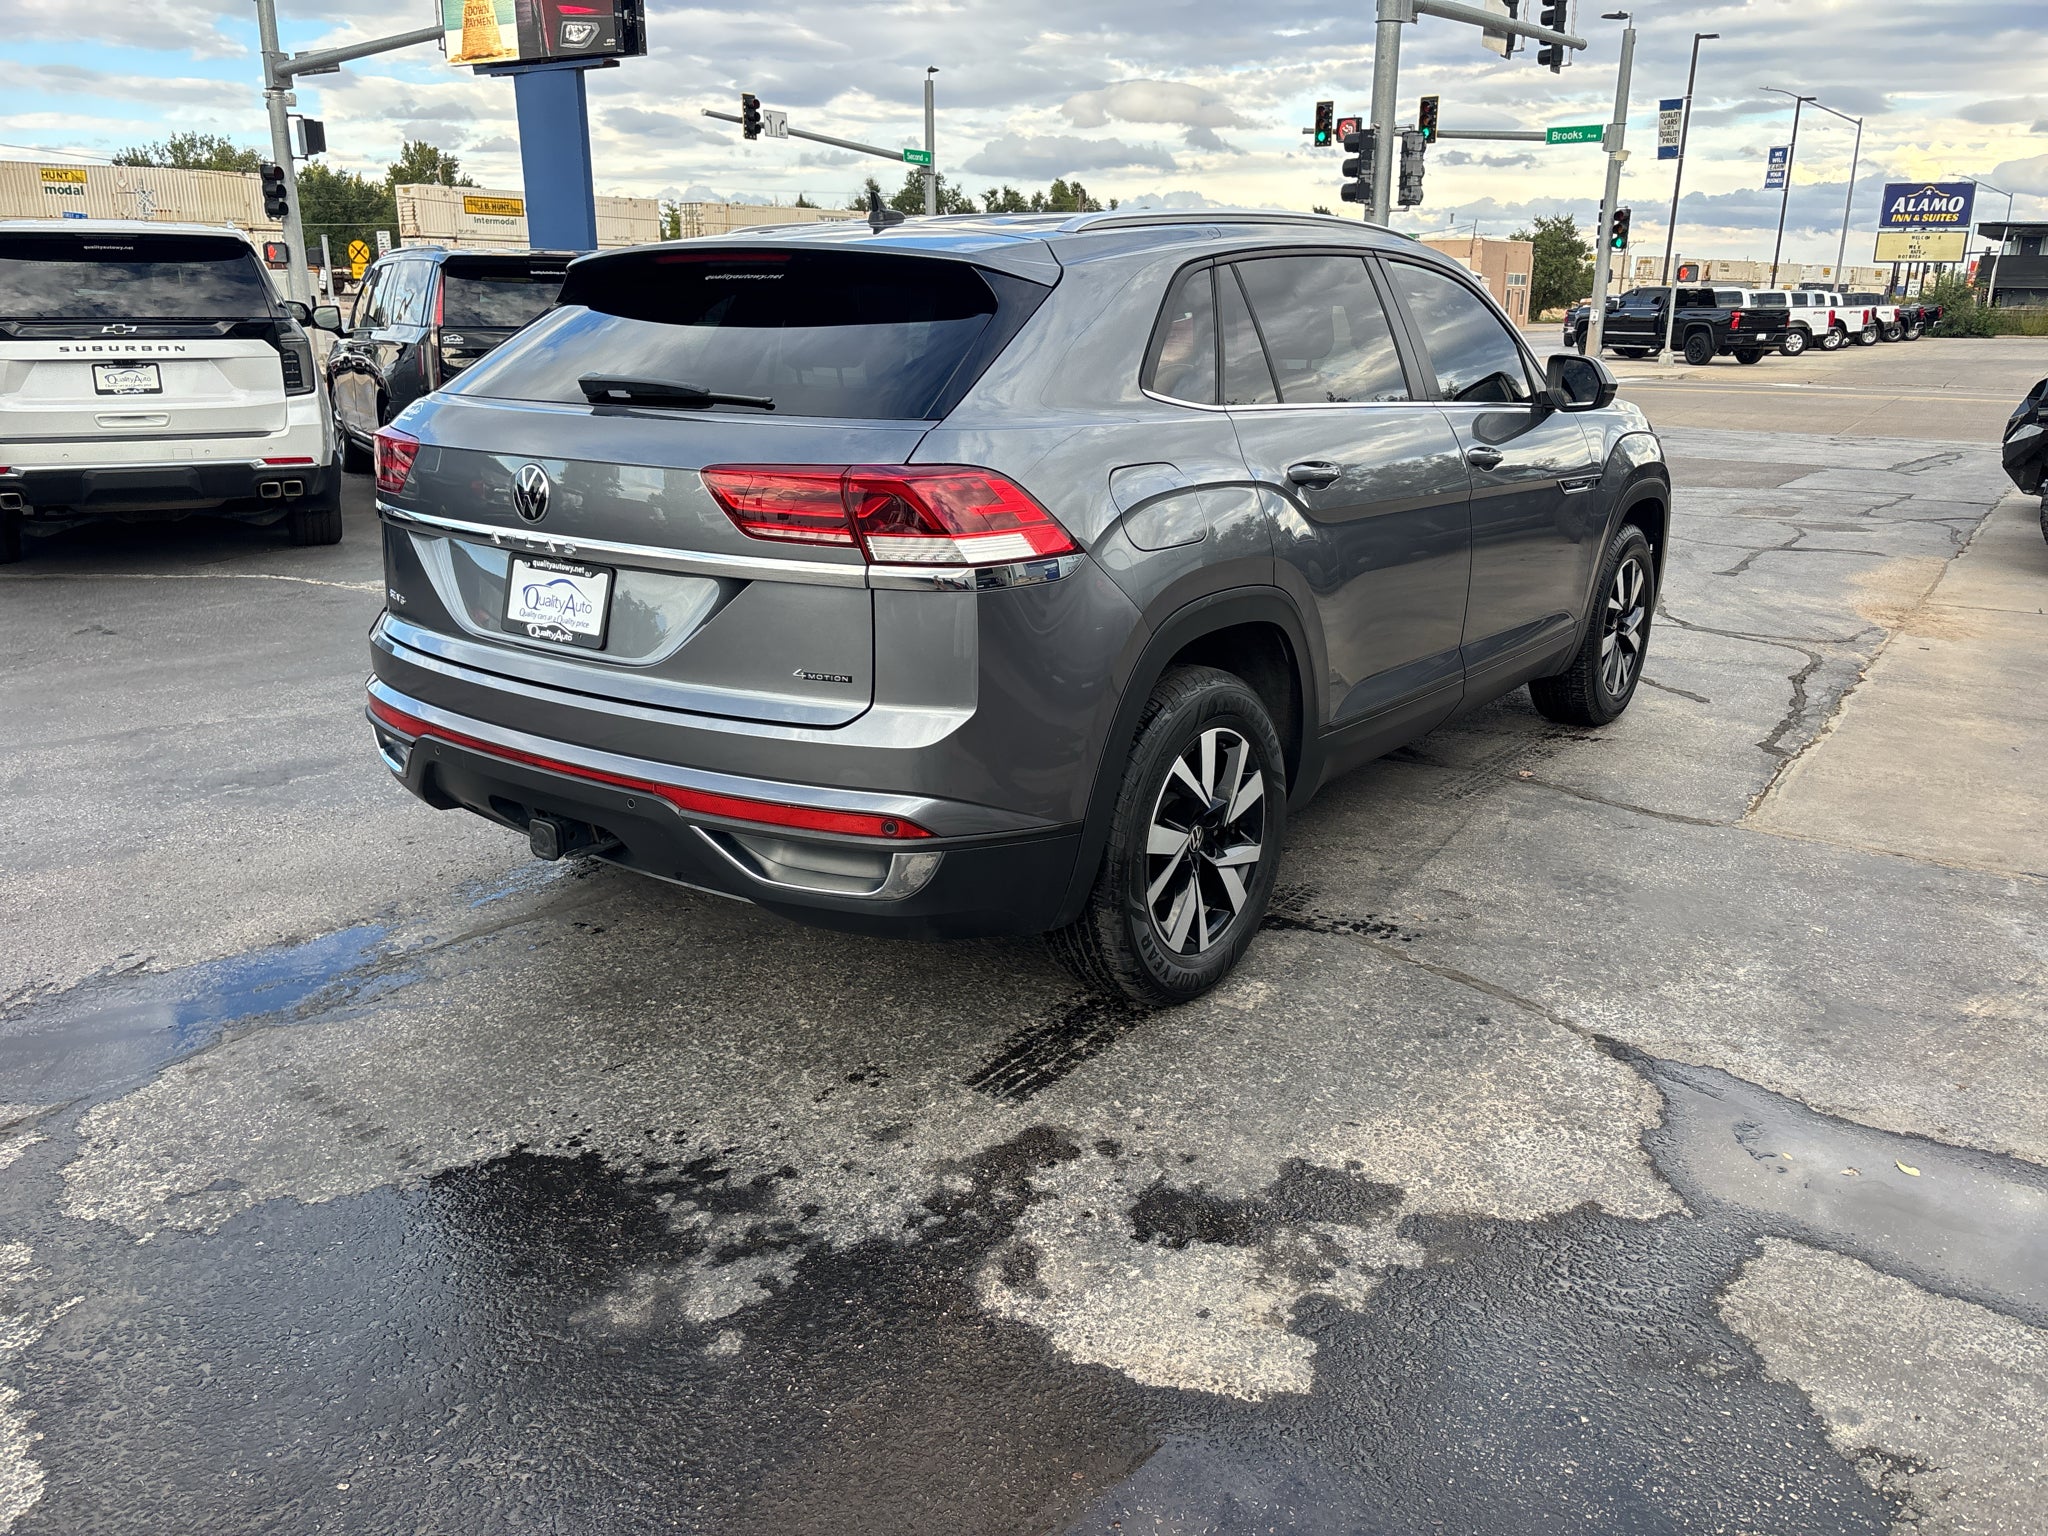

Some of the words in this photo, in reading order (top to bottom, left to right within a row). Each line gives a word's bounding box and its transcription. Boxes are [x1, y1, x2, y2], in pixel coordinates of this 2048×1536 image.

[467, 5, 489, 16] DOWN
[464, 16, 494, 28] PAYMENT
[1551, 131, 1583, 140] Brooks
[907, 152, 923, 161] Second
[41, 171, 69, 180] HUNT
[44, 185, 85, 196] modal
[1890, 196, 1965, 213] ALAMO
[473, 216, 517, 226] Intermodal
[1891, 213, 1912, 222] INN
[1913, 214, 1920, 222] &
[1922, 213, 1959, 222] SUITES
[490, 531, 577, 555] ATLAS
[532, 560, 585, 574] qualityautowy.net
[792, 668, 849, 682] 4MOTION
